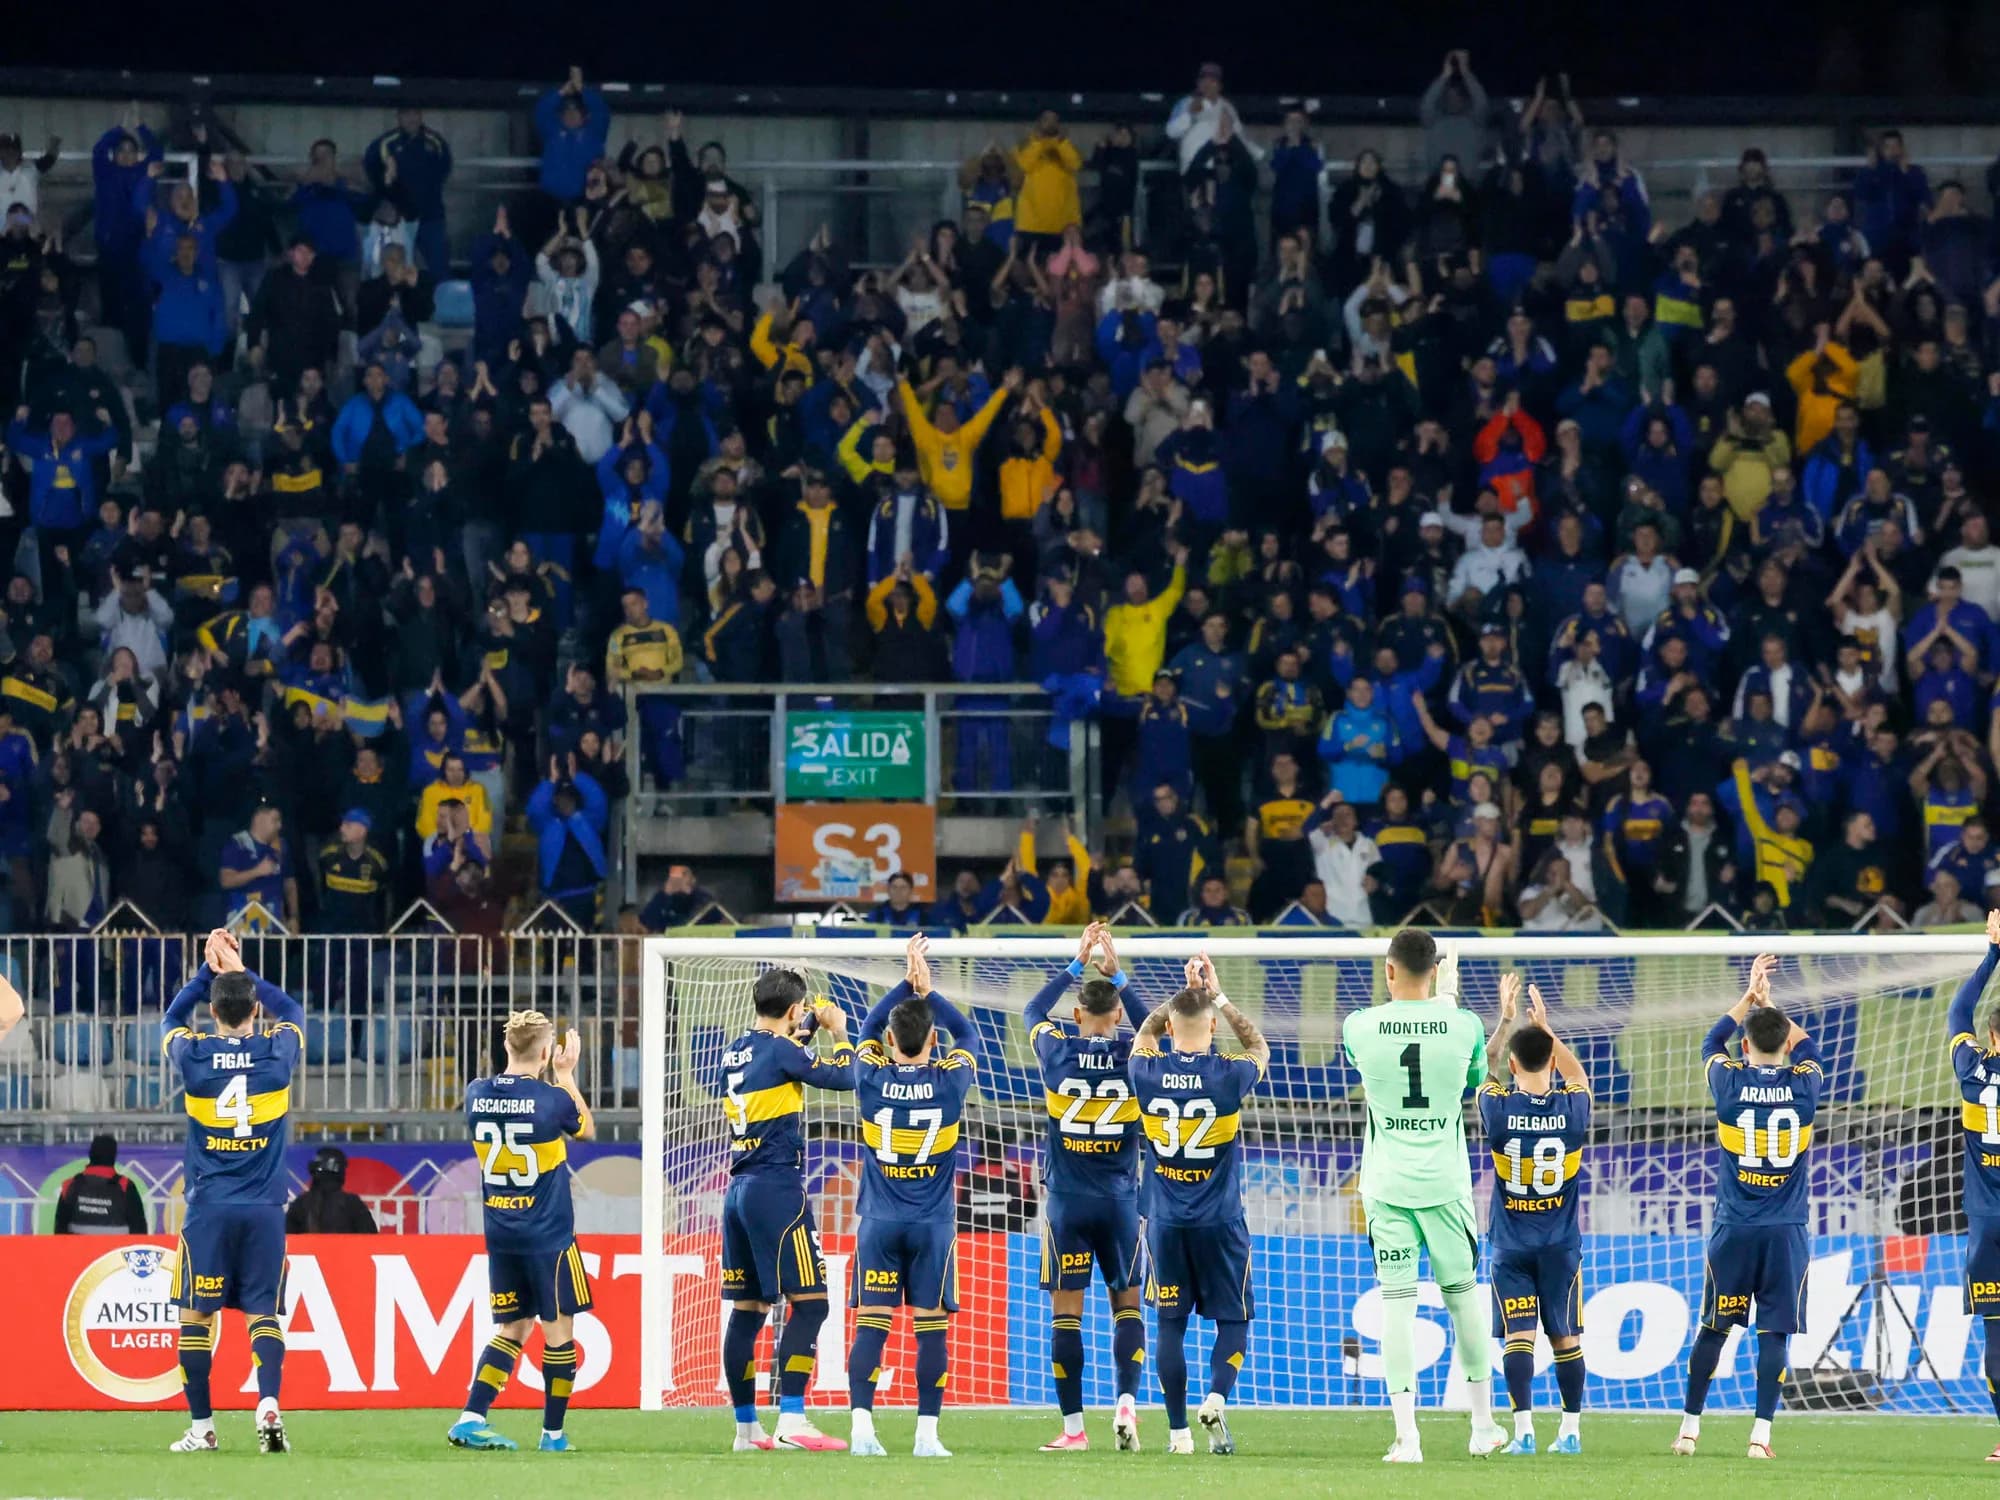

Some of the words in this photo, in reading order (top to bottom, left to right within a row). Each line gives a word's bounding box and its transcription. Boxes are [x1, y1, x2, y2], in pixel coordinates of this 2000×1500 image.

[801, 732, 910, 760] SALIDA
[832, 767, 879, 785] EXIT
[812, 823, 902, 884] S3
[1379, 1021, 1448, 1034] MONTERO
[212, 1052, 255, 1070] FIGAL
[1078, 1053, 1114, 1070] VILLA
[1162, 1074, 1203, 1089] COSTA
[1399, 1043, 1430, 1109] 1
[881, 1082, 934, 1100] LOZANO
[1739, 1086, 1794, 1102] ARANDA
[215, 1074, 254, 1138] 4
[471, 1098, 536, 1114] ASCACIBAR
[1057, 1077, 1129, 1135] 22
[1147, 1098, 1217, 1159] 32
[1384, 1117, 1448, 1131] DIRECTV
[1507, 1114, 1567, 1131] DELGADO
[205, 1135, 268, 1151] DIRECTV
[873, 1107, 943, 1165] 17
[1062, 1137, 1122, 1153] DIRECTV
[1736, 1108, 1801, 1168] 10
[475, 1121, 540, 1187] 25
[1154, 1163, 1213, 1182] DIRECTV
[1503, 1137, 1566, 1195] 18
[1737, 1169, 1790, 1187] DIRECT
[1504, 1196, 1564, 1211] DIRECTV
[1061, 1251, 1091, 1269] pax
[1379, 1247, 1412, 1264] pax
[195, 1274, 224, 1290] pax
[865, 1269, 898, 1286] pax
[1504, 1295, 1536, 1314] pax
[1718, 1295, 1748, 1310] pax
[97, 1302, 176, 1323] AMSTE
[111, 1332, 173, 1349] LAGER
